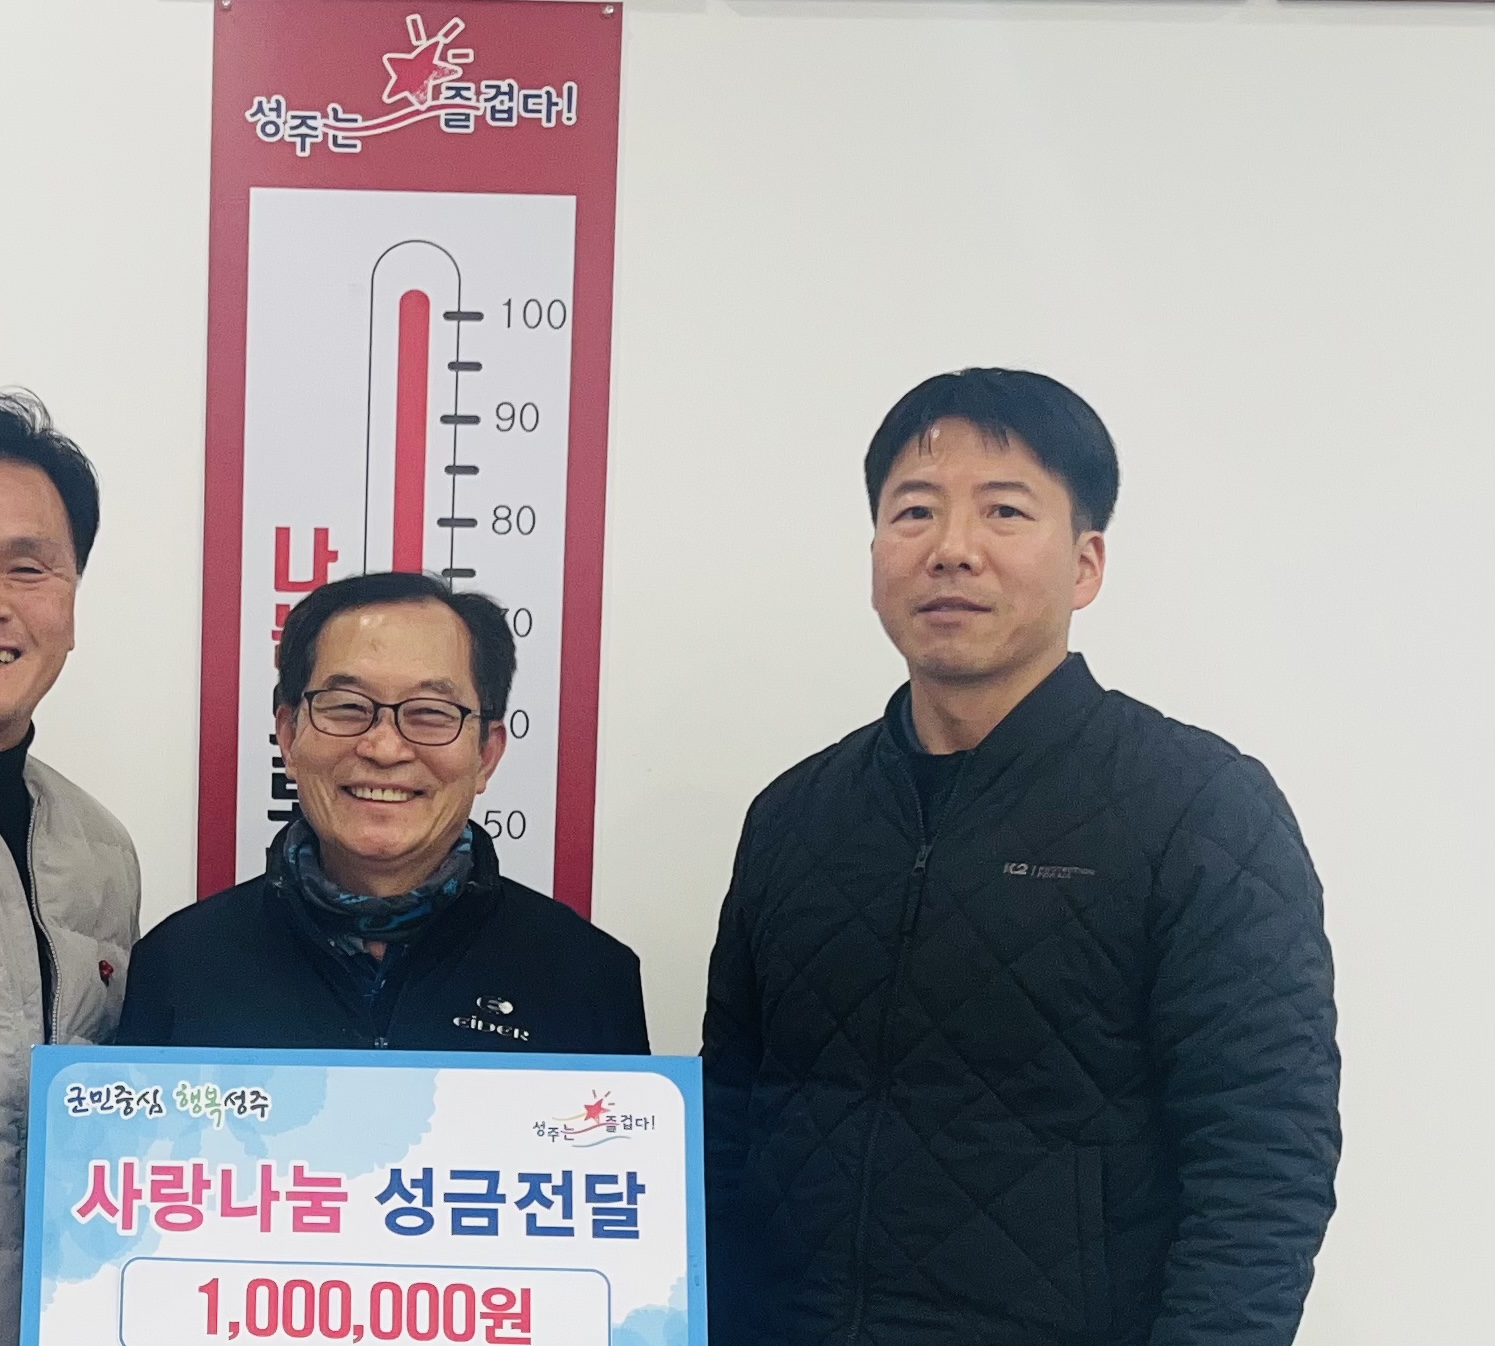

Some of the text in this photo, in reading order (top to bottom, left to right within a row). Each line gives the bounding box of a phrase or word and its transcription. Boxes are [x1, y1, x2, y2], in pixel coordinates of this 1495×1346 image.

[246, 80, 577, 156] 성주는 즐겁다!
[502, 298, 567, 329] 100
[495, 401, 540, 433] 90
[491, 504, 536, 536] 80
[484, 810, 527, 840] 50
[67, 1083, 270, 1128] 군민중심 행복성주
[532, 1114, 656, 1143] 성주는 즐겁다!
[78, 1161, 646, 1239] 사랑나눔 성금전달
[198, 1277, 533, 1346] 1,000,000원
